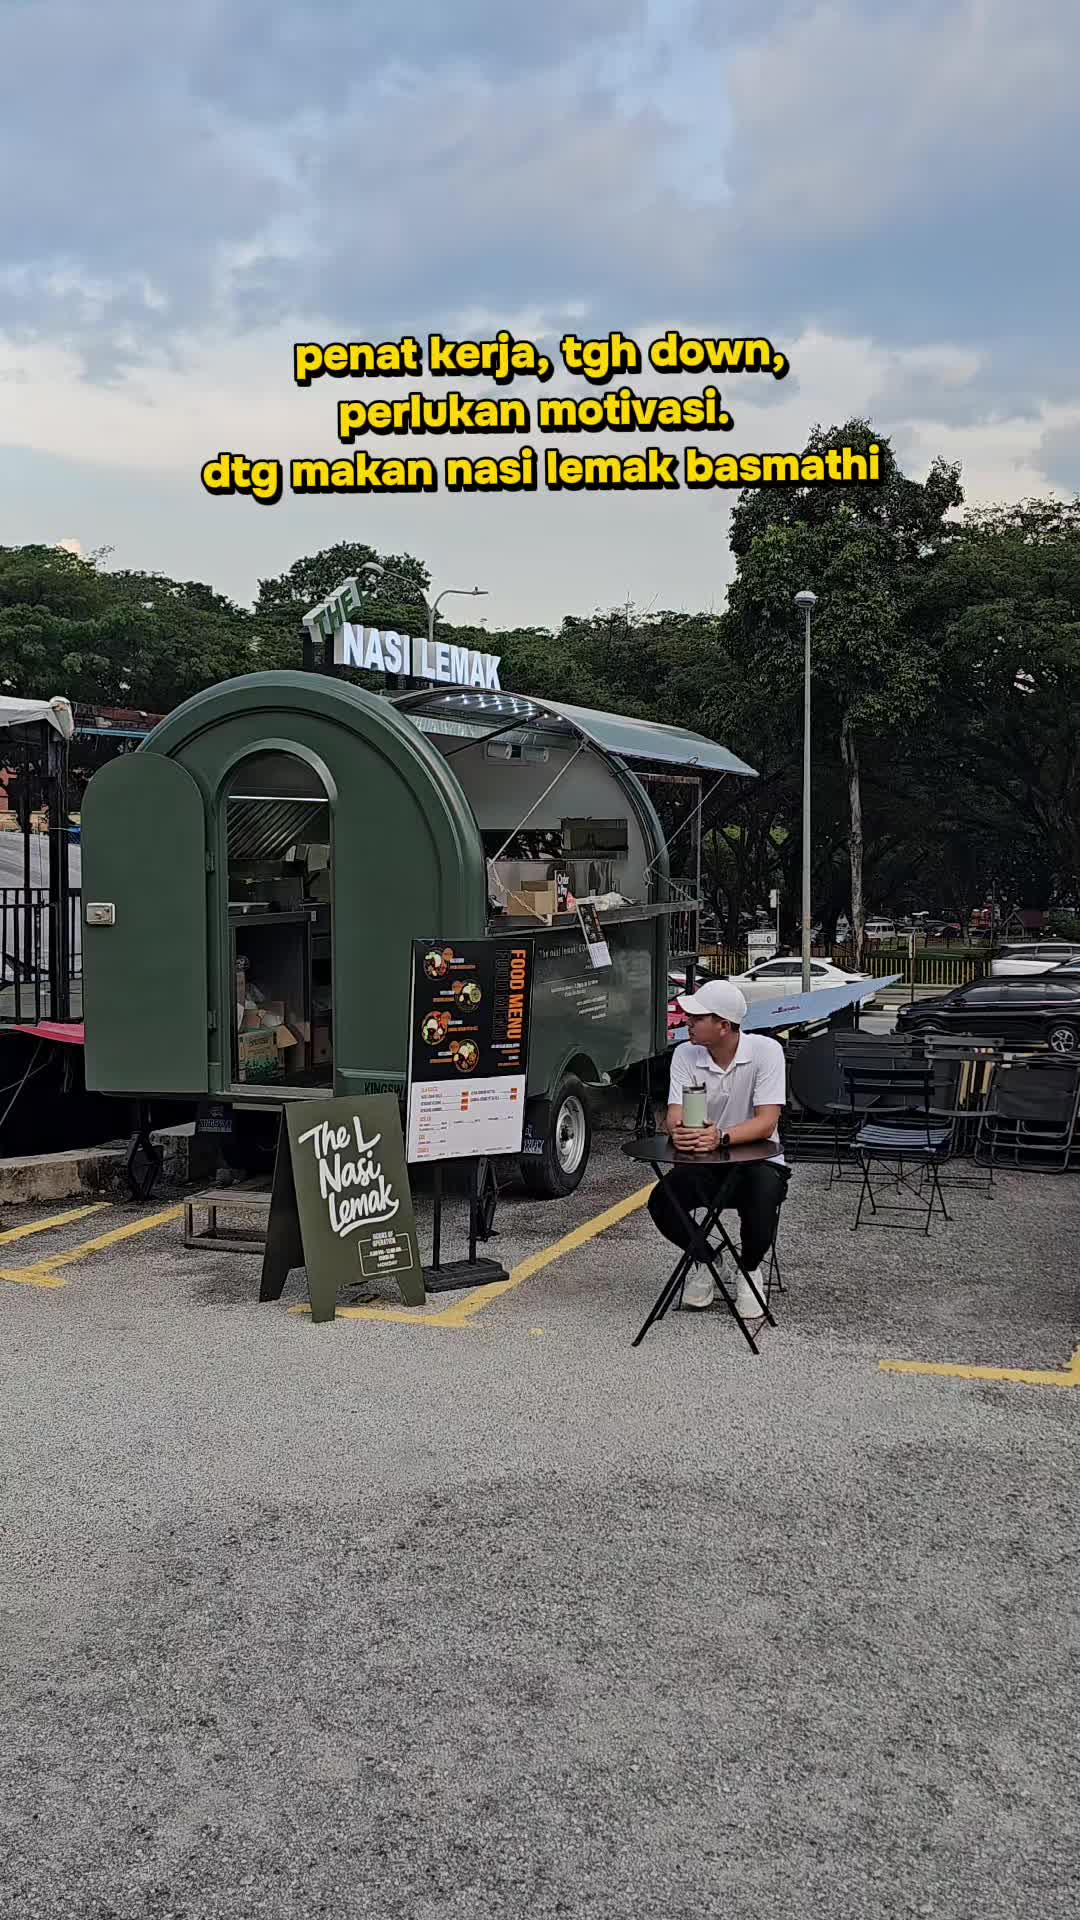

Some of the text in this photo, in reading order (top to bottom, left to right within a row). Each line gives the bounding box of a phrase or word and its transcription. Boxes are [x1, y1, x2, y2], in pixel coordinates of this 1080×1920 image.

[334, 621, 501, 690] NASI LEMAK
[510, 949, 527, 990] FOOD
[506, 993, 524, 1039] MENU
[298, 1115, 382, 1160] The L
[317, 1149, 381, 1200] Nasi
[327, 1174, 400, 1237] Lemak
